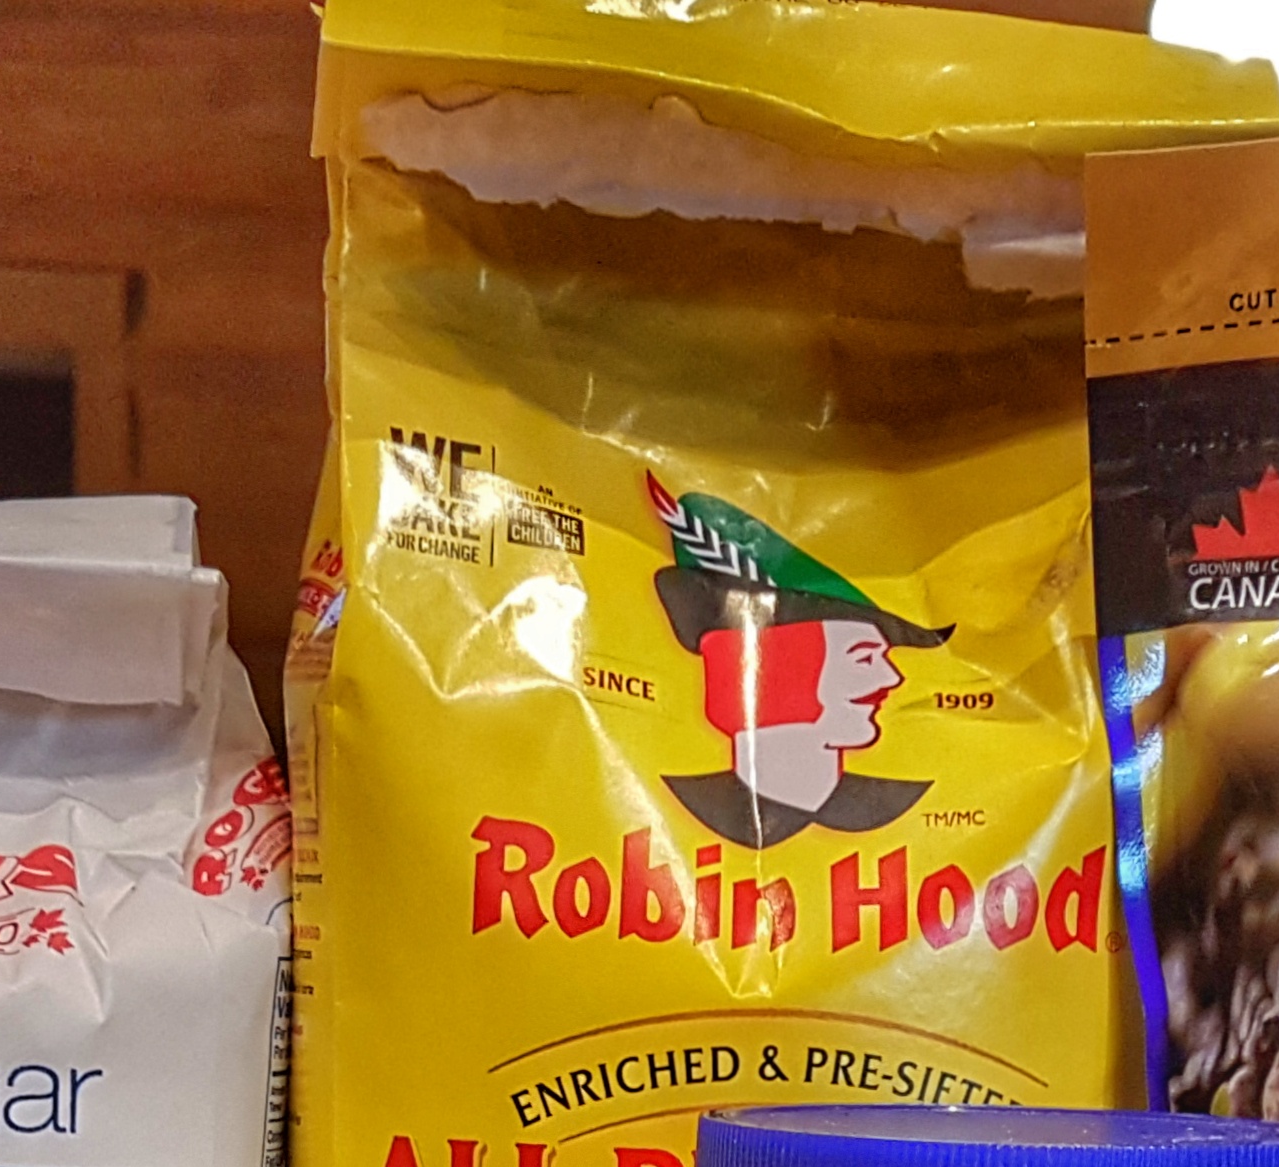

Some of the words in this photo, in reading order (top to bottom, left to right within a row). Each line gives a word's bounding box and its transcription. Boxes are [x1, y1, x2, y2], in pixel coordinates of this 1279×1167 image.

[1228, 288, 1276, 312] CUT
[537, 485, 554, 498] AN
[514, 504, 550, 527] FREE
[552, 511, 581, 534] THE
[387, 530, 417, 552] FOR
[418, 535, 482, 565] CHANGE
[510, 524, 582, 553] CHILDREN
[1188, 560, 1242, 577] GROWN
[1244, 559, 1260, 574] IN
[582, 665, 656, 702] SINCE
[932, 690, 996, 712] 1909
[921, 810, 986, 829] TM/MC
[470, 814, 797, 951] Robin
[829, 843, 1107, 954] Hood
[509, 1044, 740, 1129] ENRICHED
[758, 1044, 790, 1083] &
